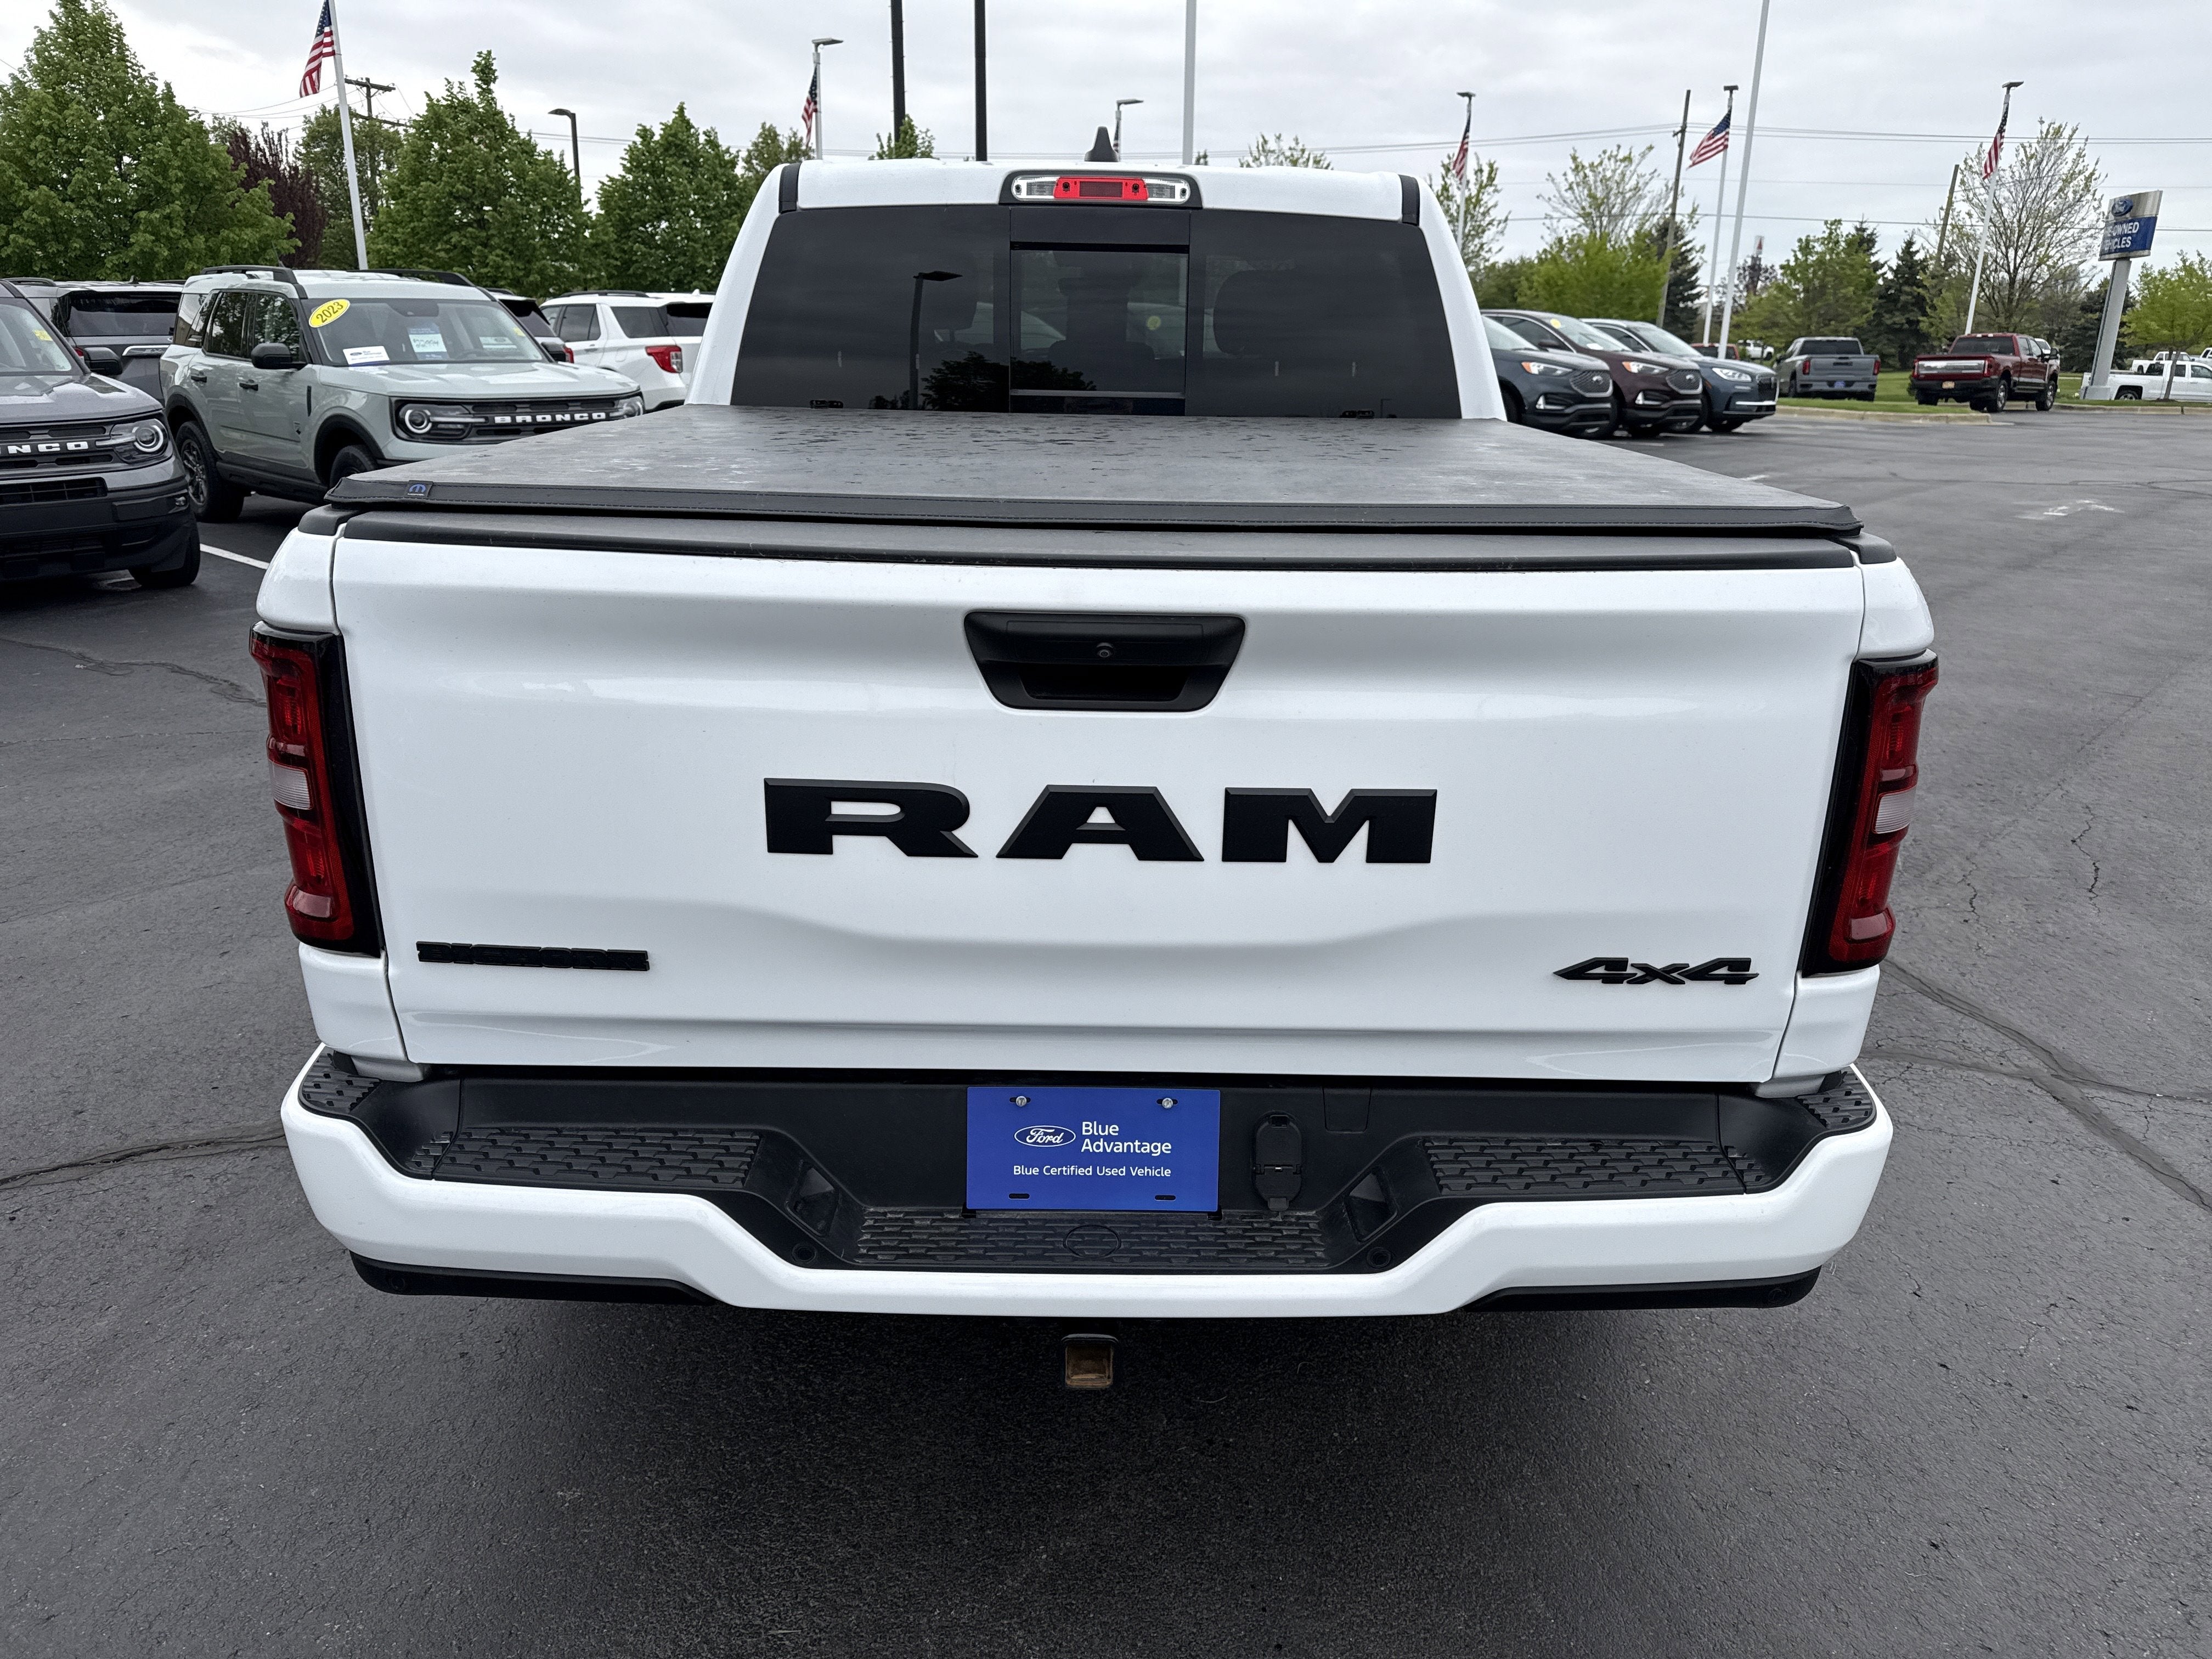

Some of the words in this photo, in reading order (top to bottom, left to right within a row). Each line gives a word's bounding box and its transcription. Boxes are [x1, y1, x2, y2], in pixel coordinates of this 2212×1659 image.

[316, 302, 343, 323] 2023
[494, 413, 606, 424] BRONCO
[0, 441, 89, 454] NCO
[764, 777, 1437, 864] RAM
[1025, 1127, 1065, 1143] Ford
[1081, 1121, 1119, 1136] Blue
[1081, 1138, 1172, 1156] Advantage
[1013, 1165, 1039, 1175] Blue
[1043, 1165, 1092, 1176] Certified
[1097, 1166, 1126, 1176] Used
[1130, 1166, 1171, 1177] Vehicle
